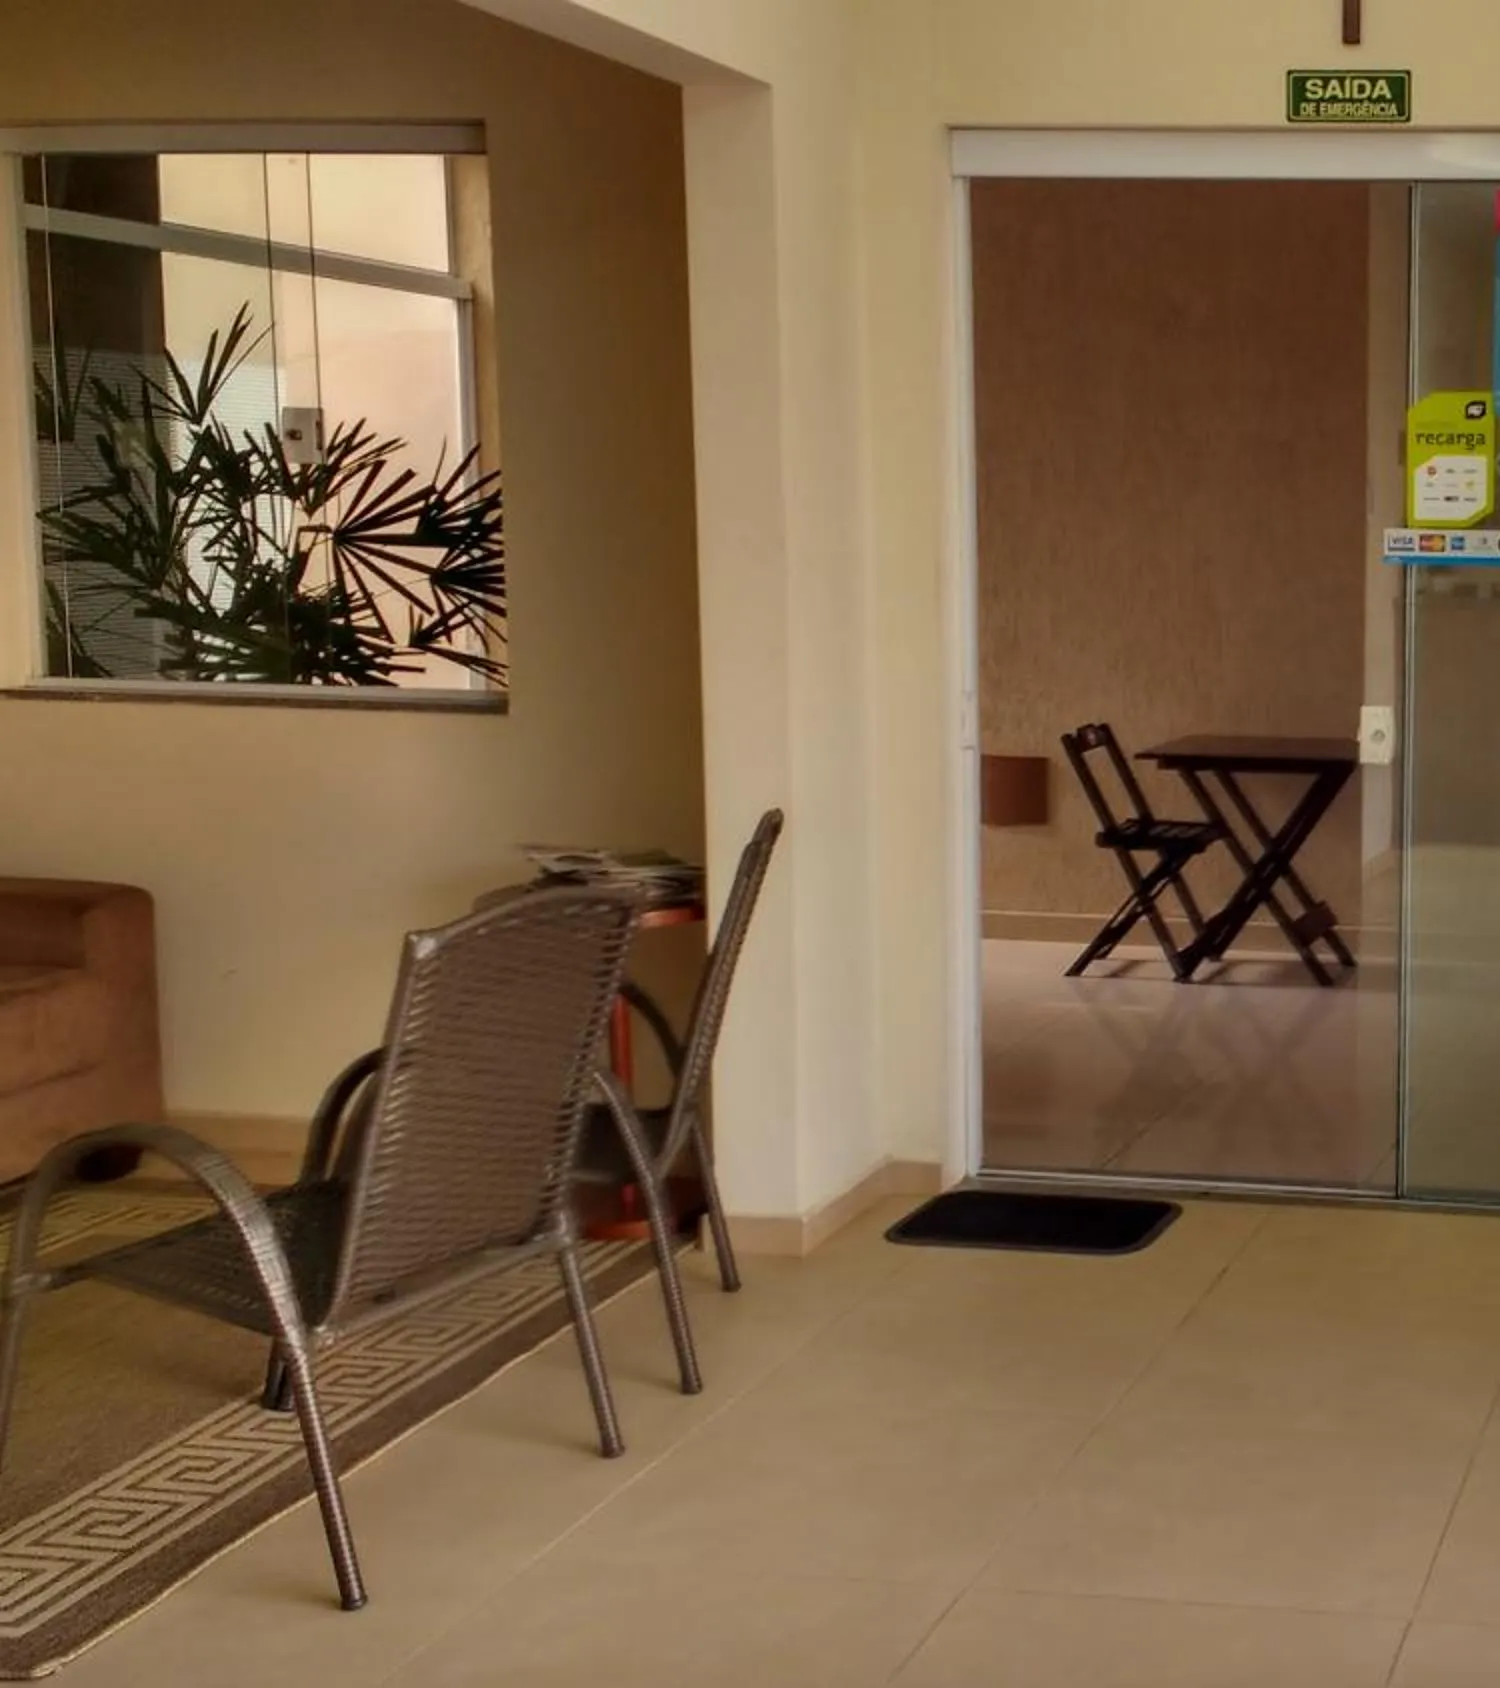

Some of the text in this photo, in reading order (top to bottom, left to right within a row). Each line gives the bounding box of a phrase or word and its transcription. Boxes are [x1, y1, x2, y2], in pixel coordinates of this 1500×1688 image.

[1304, 77, 1392, 99] SAÍDA
[1301, 101, 1398, 116] DE EMERGÊNCIA
[1415, 432, 1486, 450] recarga
